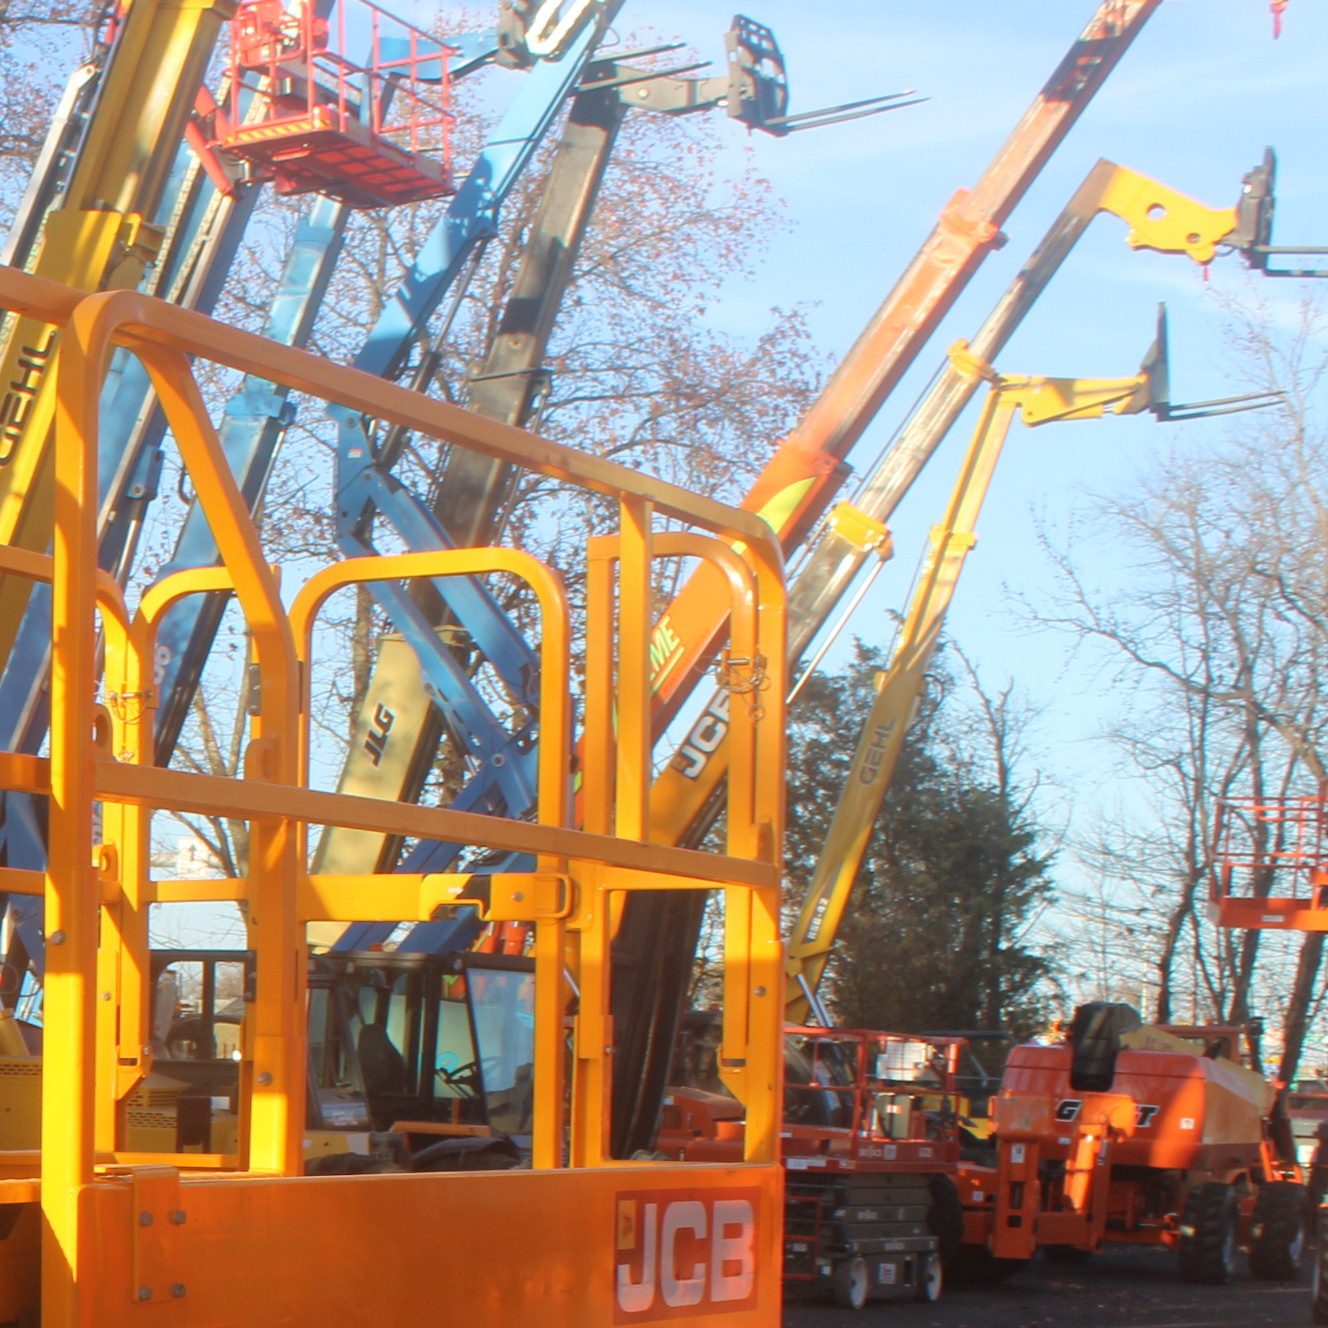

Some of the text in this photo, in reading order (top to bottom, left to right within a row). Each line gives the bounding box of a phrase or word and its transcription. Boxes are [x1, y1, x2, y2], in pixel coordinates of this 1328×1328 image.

[364, 702, 395, 768] JLG
[858, 717, 897, 786] GEHL
[617, 1199, 755, 1313] JCB
